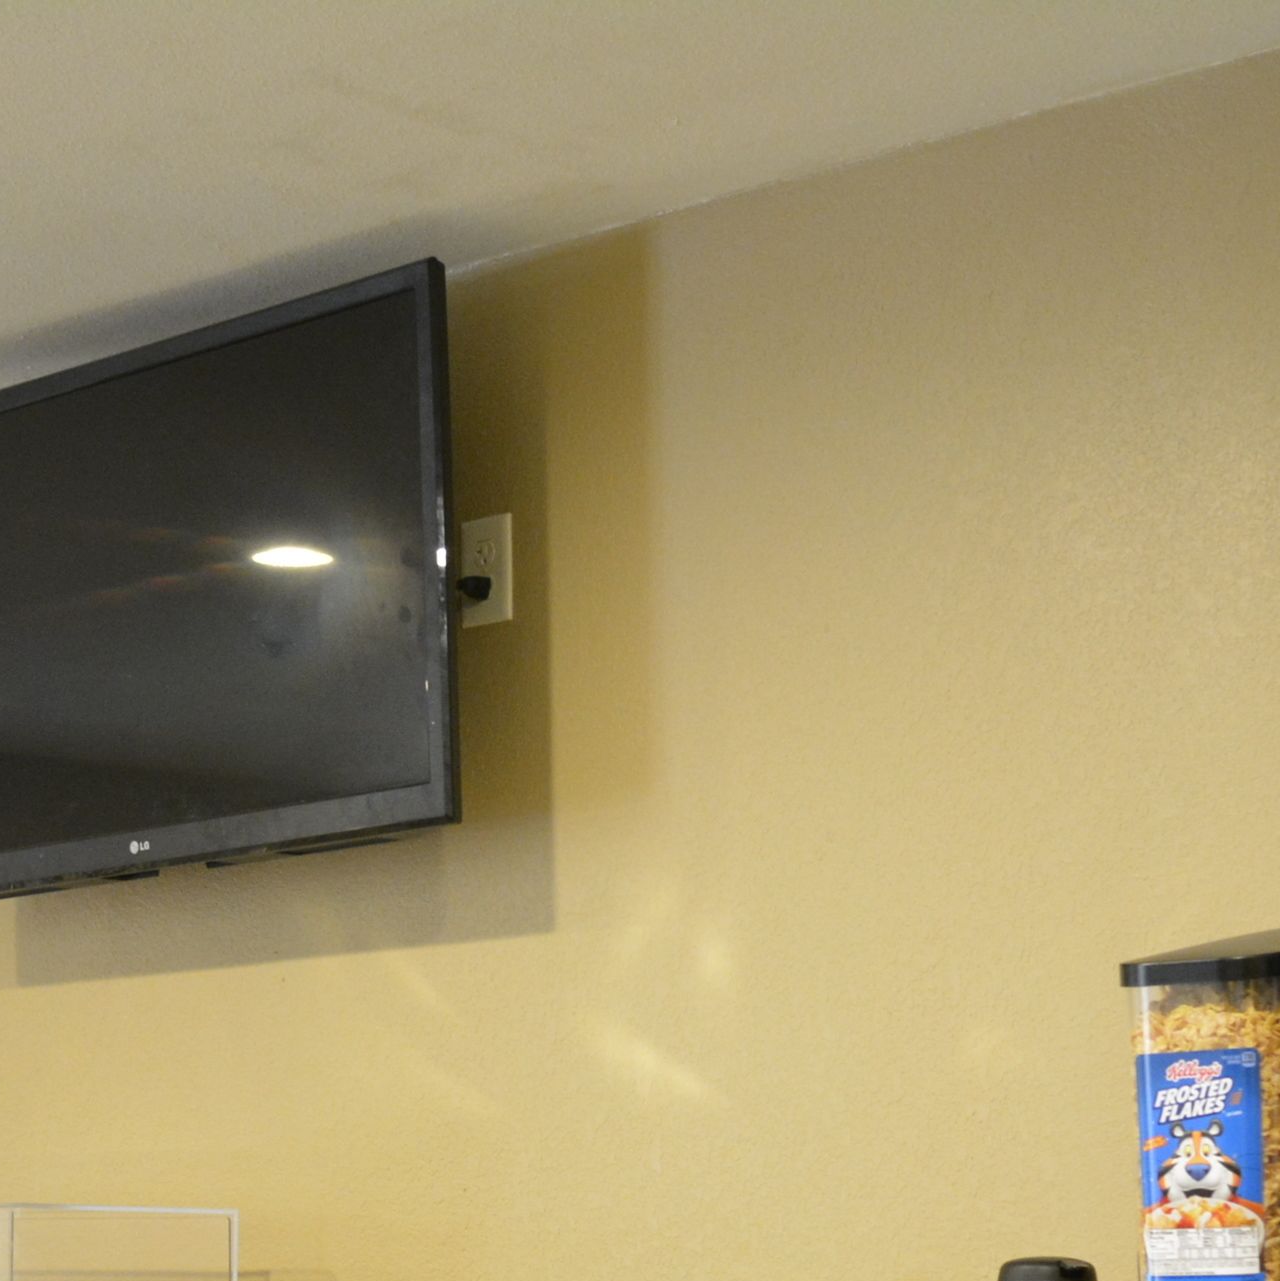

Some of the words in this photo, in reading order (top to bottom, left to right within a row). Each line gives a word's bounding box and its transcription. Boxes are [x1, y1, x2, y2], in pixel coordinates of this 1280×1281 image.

[139, 840, 151, 852] LG
[1165, 1059, 1223, 1084] Kellogg's
[1154, 1077, 1233, 1109] FROSTED
[1158, 1095, 1226, 1124] FLAKES
